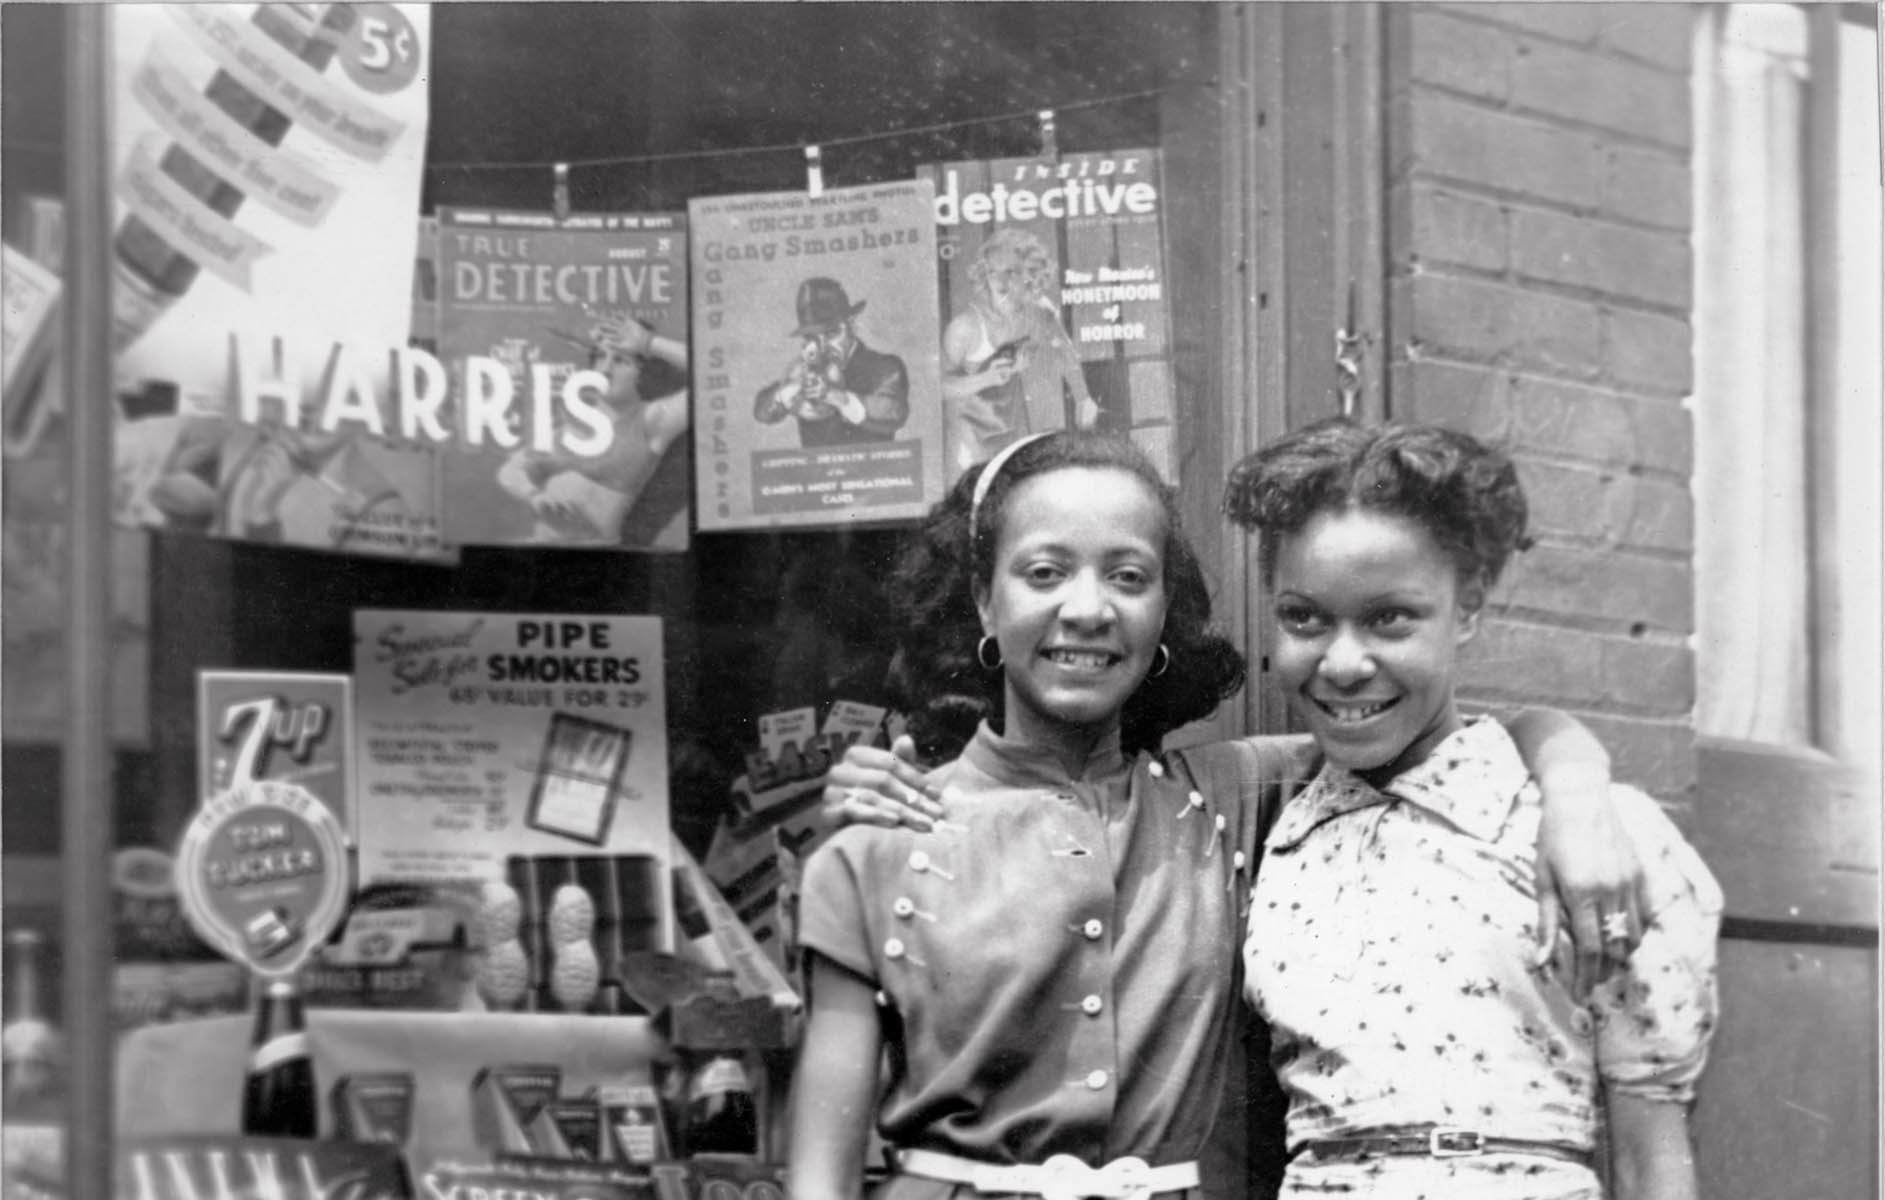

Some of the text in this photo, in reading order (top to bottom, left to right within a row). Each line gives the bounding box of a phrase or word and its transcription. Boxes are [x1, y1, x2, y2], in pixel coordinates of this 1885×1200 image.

[360, 18, 409, 70] 5¢
[1014, 158, 1140, 181] INSIDE
[933, 170, 1157, 225] detective
[750, 213, 815, 233] UNCLE
[456, 235, 530, 257] TRUE
[703, 228, 919, 263] Gang Smashers
[456, 260, 671, 303] DETECTIVE
[1060, 283, 1162, 304] HONEYMOON
[1080, 321, 1146, 342] HORROR
[228, 332, 615, 458] HARRIS
[517, 620, 611, 649] PIPE
[487, 653, 641, 684] SMOKERS
[564, 688, 608, 708] FOR
